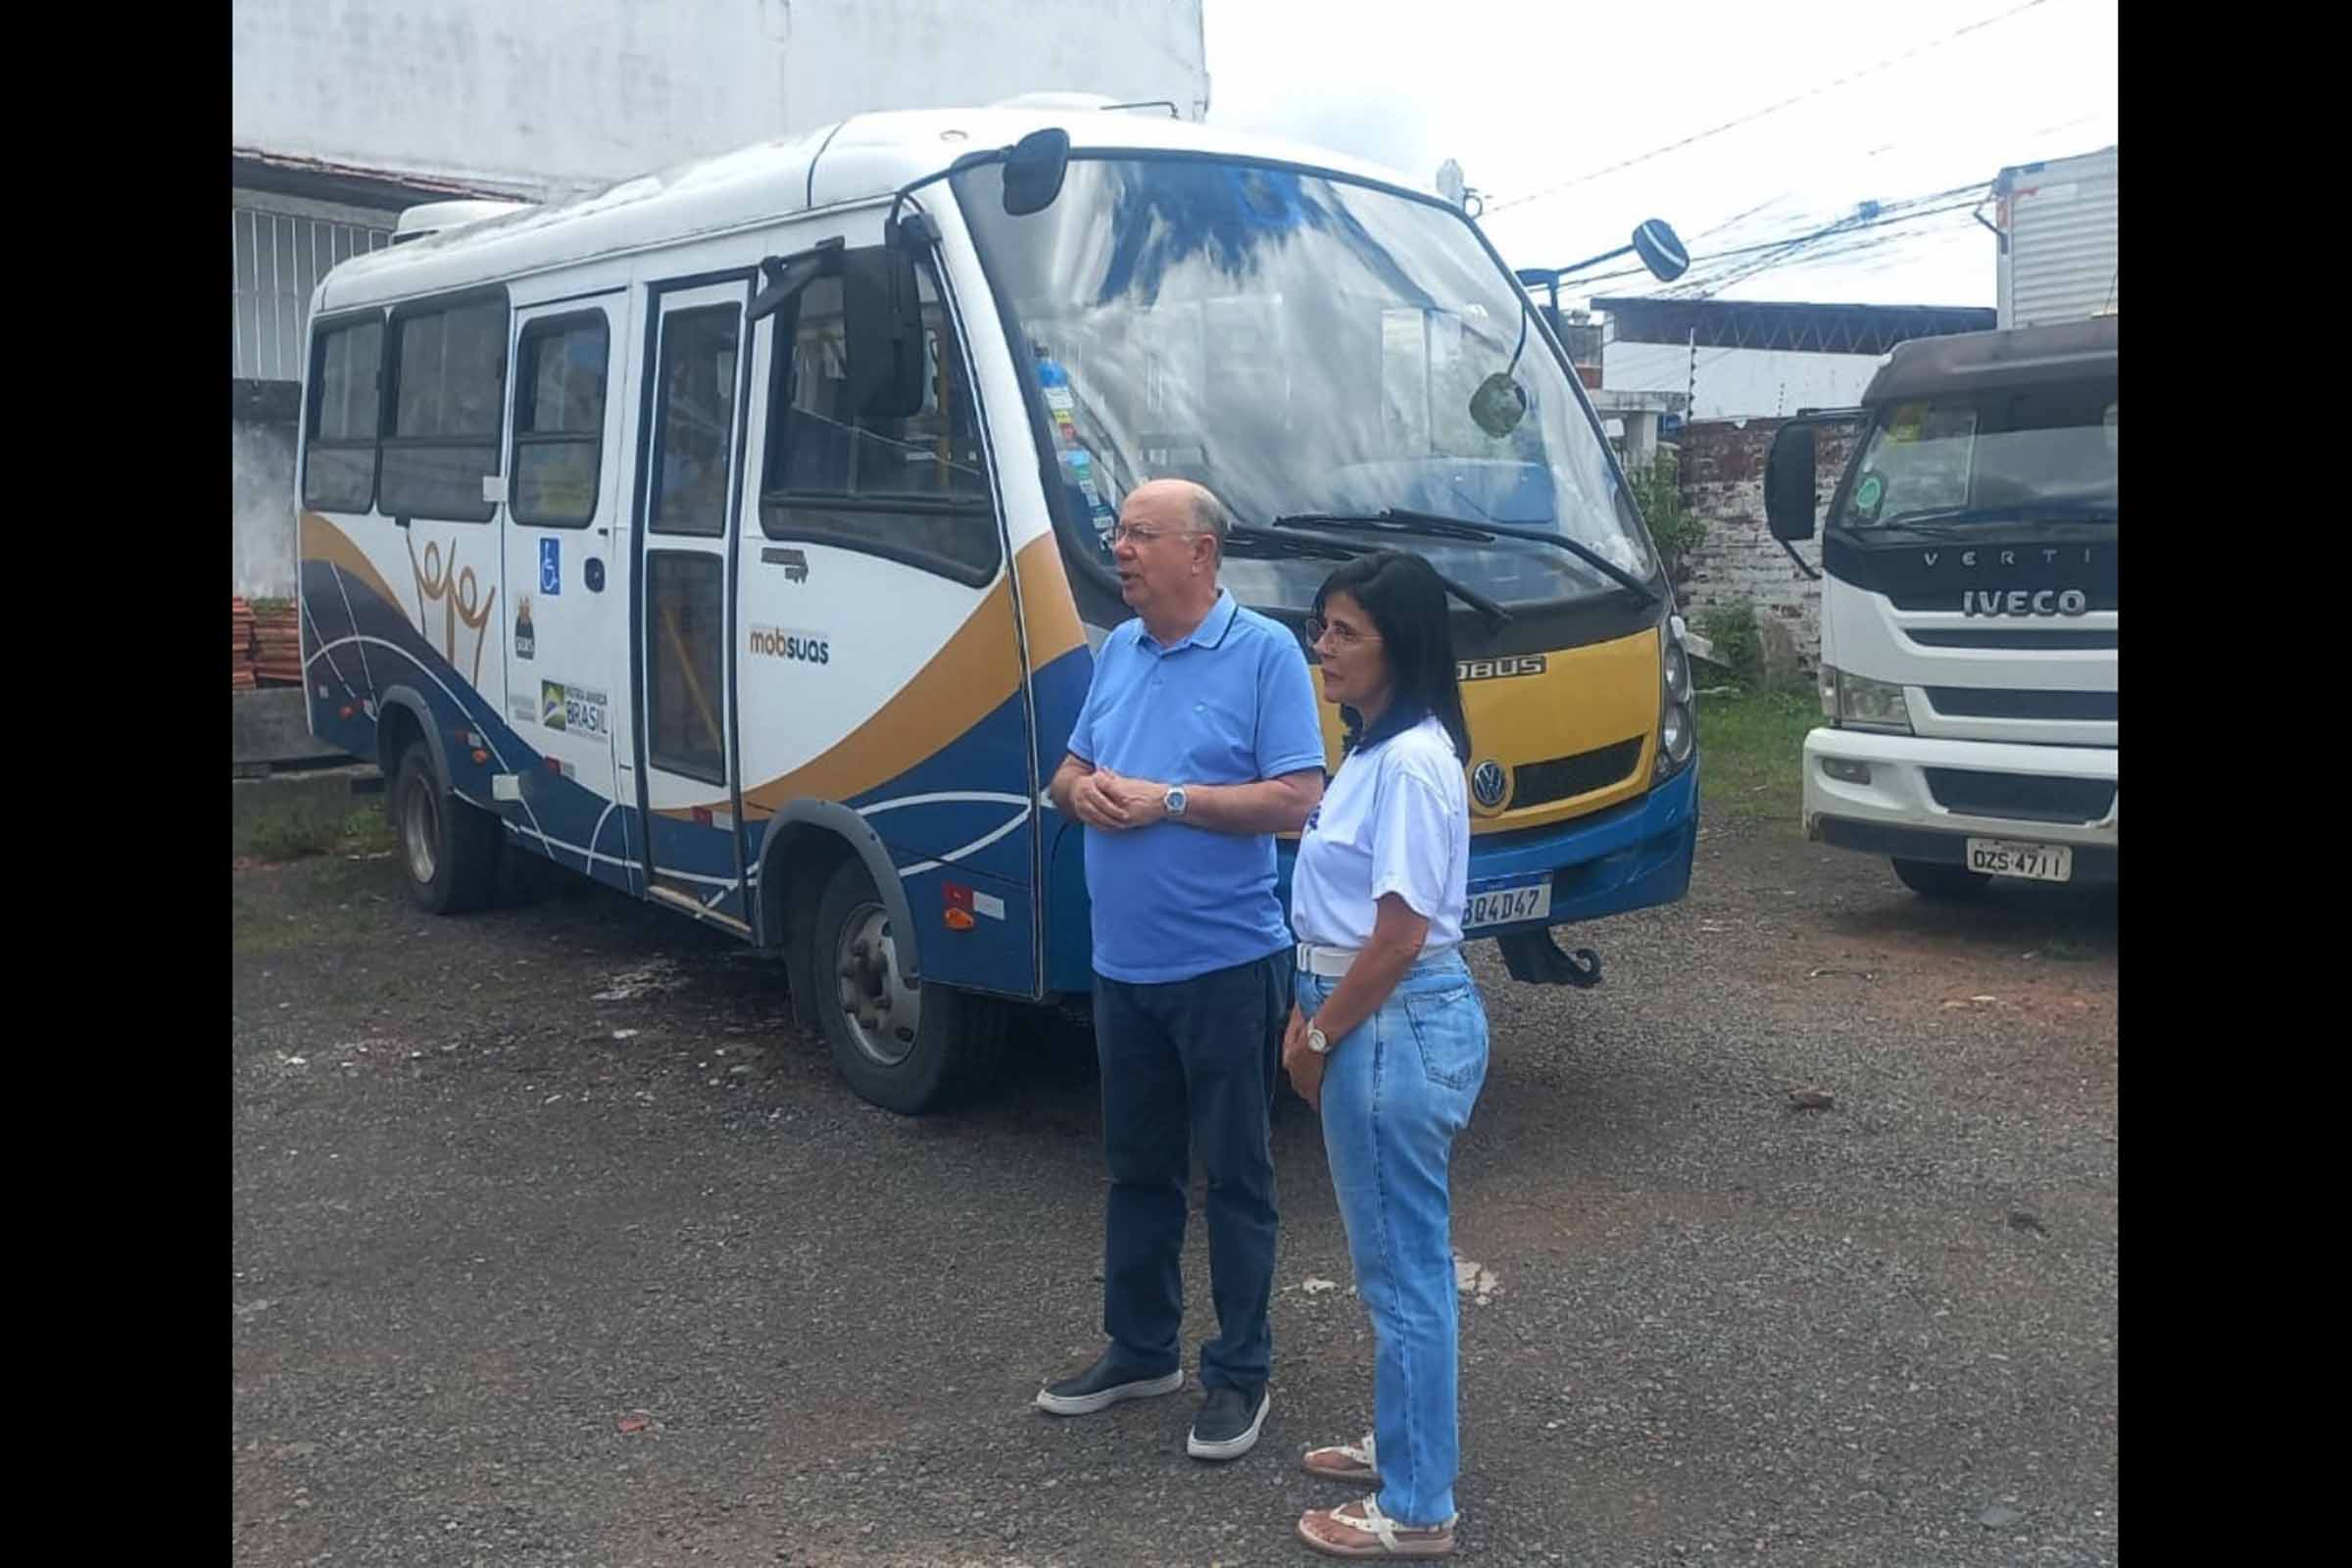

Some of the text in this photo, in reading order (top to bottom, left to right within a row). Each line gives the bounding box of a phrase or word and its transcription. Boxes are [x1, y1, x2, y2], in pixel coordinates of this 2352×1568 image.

[1924, 548, 2091, 566] VERTI
[1963, 590, 2086, 617] IVECO
[750, 626, 829, 664] mobsuas
[565, 700, 609, 734] BRASIL
